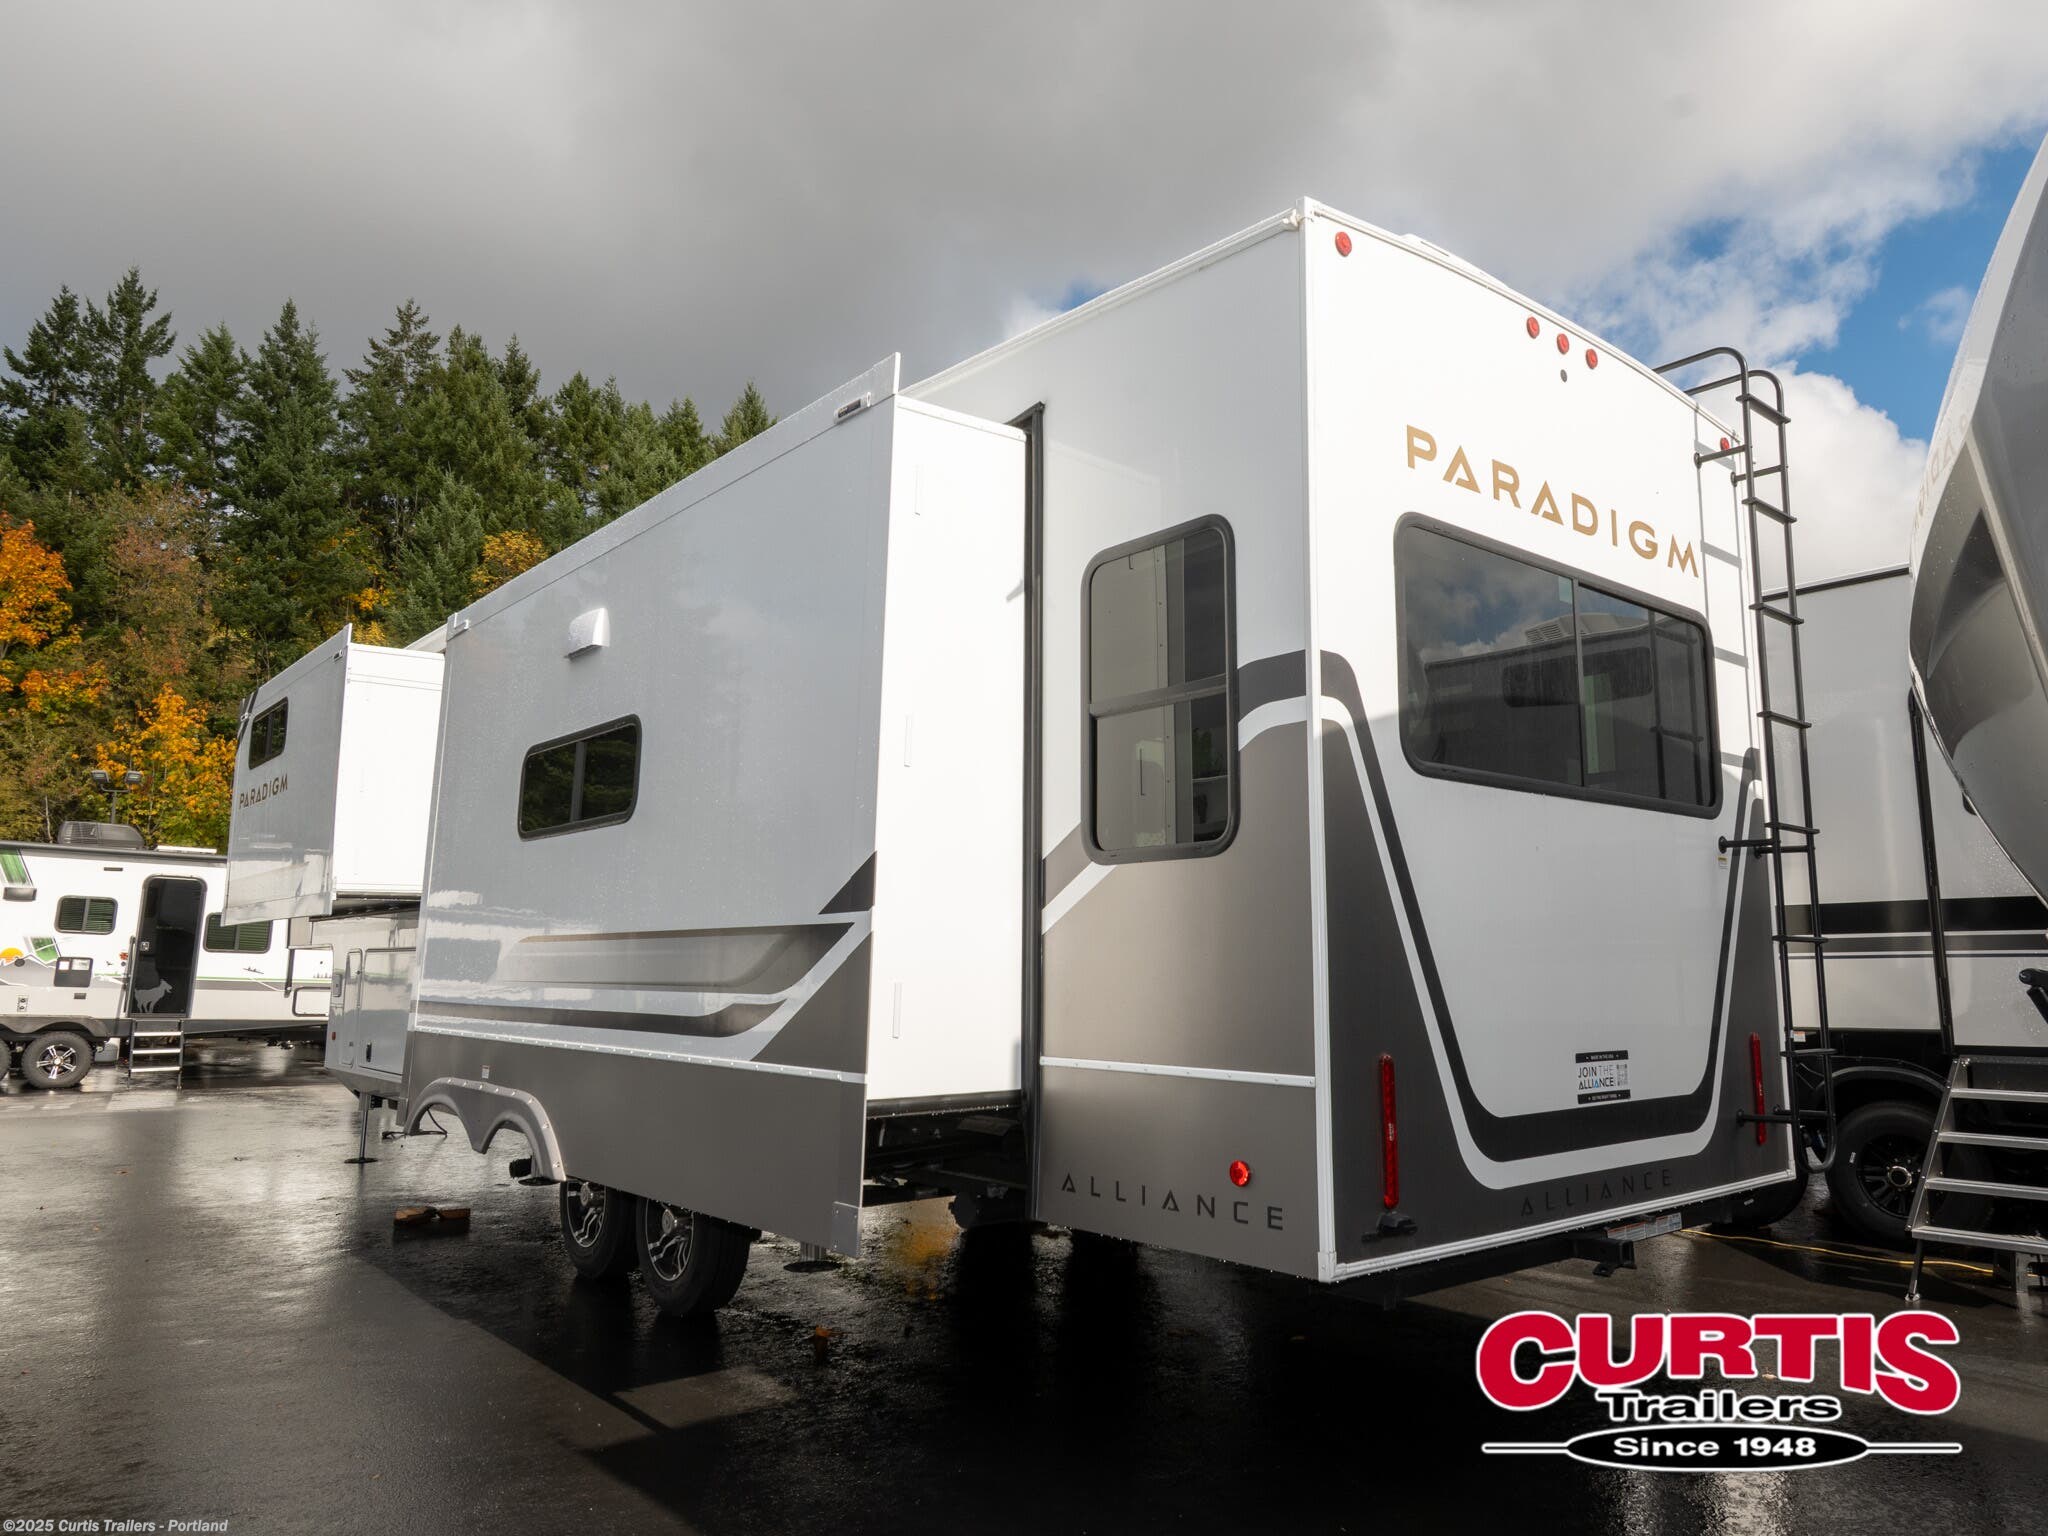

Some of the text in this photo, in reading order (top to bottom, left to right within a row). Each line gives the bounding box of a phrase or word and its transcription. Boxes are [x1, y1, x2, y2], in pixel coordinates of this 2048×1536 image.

[1406, 423, 1700, 579] PARADIGM
[239, 773, 288, 809] PARADIGM
[1578, 1066, 1598, 1078] JOIN
[1578, 1077, 1614, 1090] ALLIANCE
[1061, 1172, 1284, 1231] ALLIANCE
[1520, 1168, 1672, 1217] ALLIANCE
